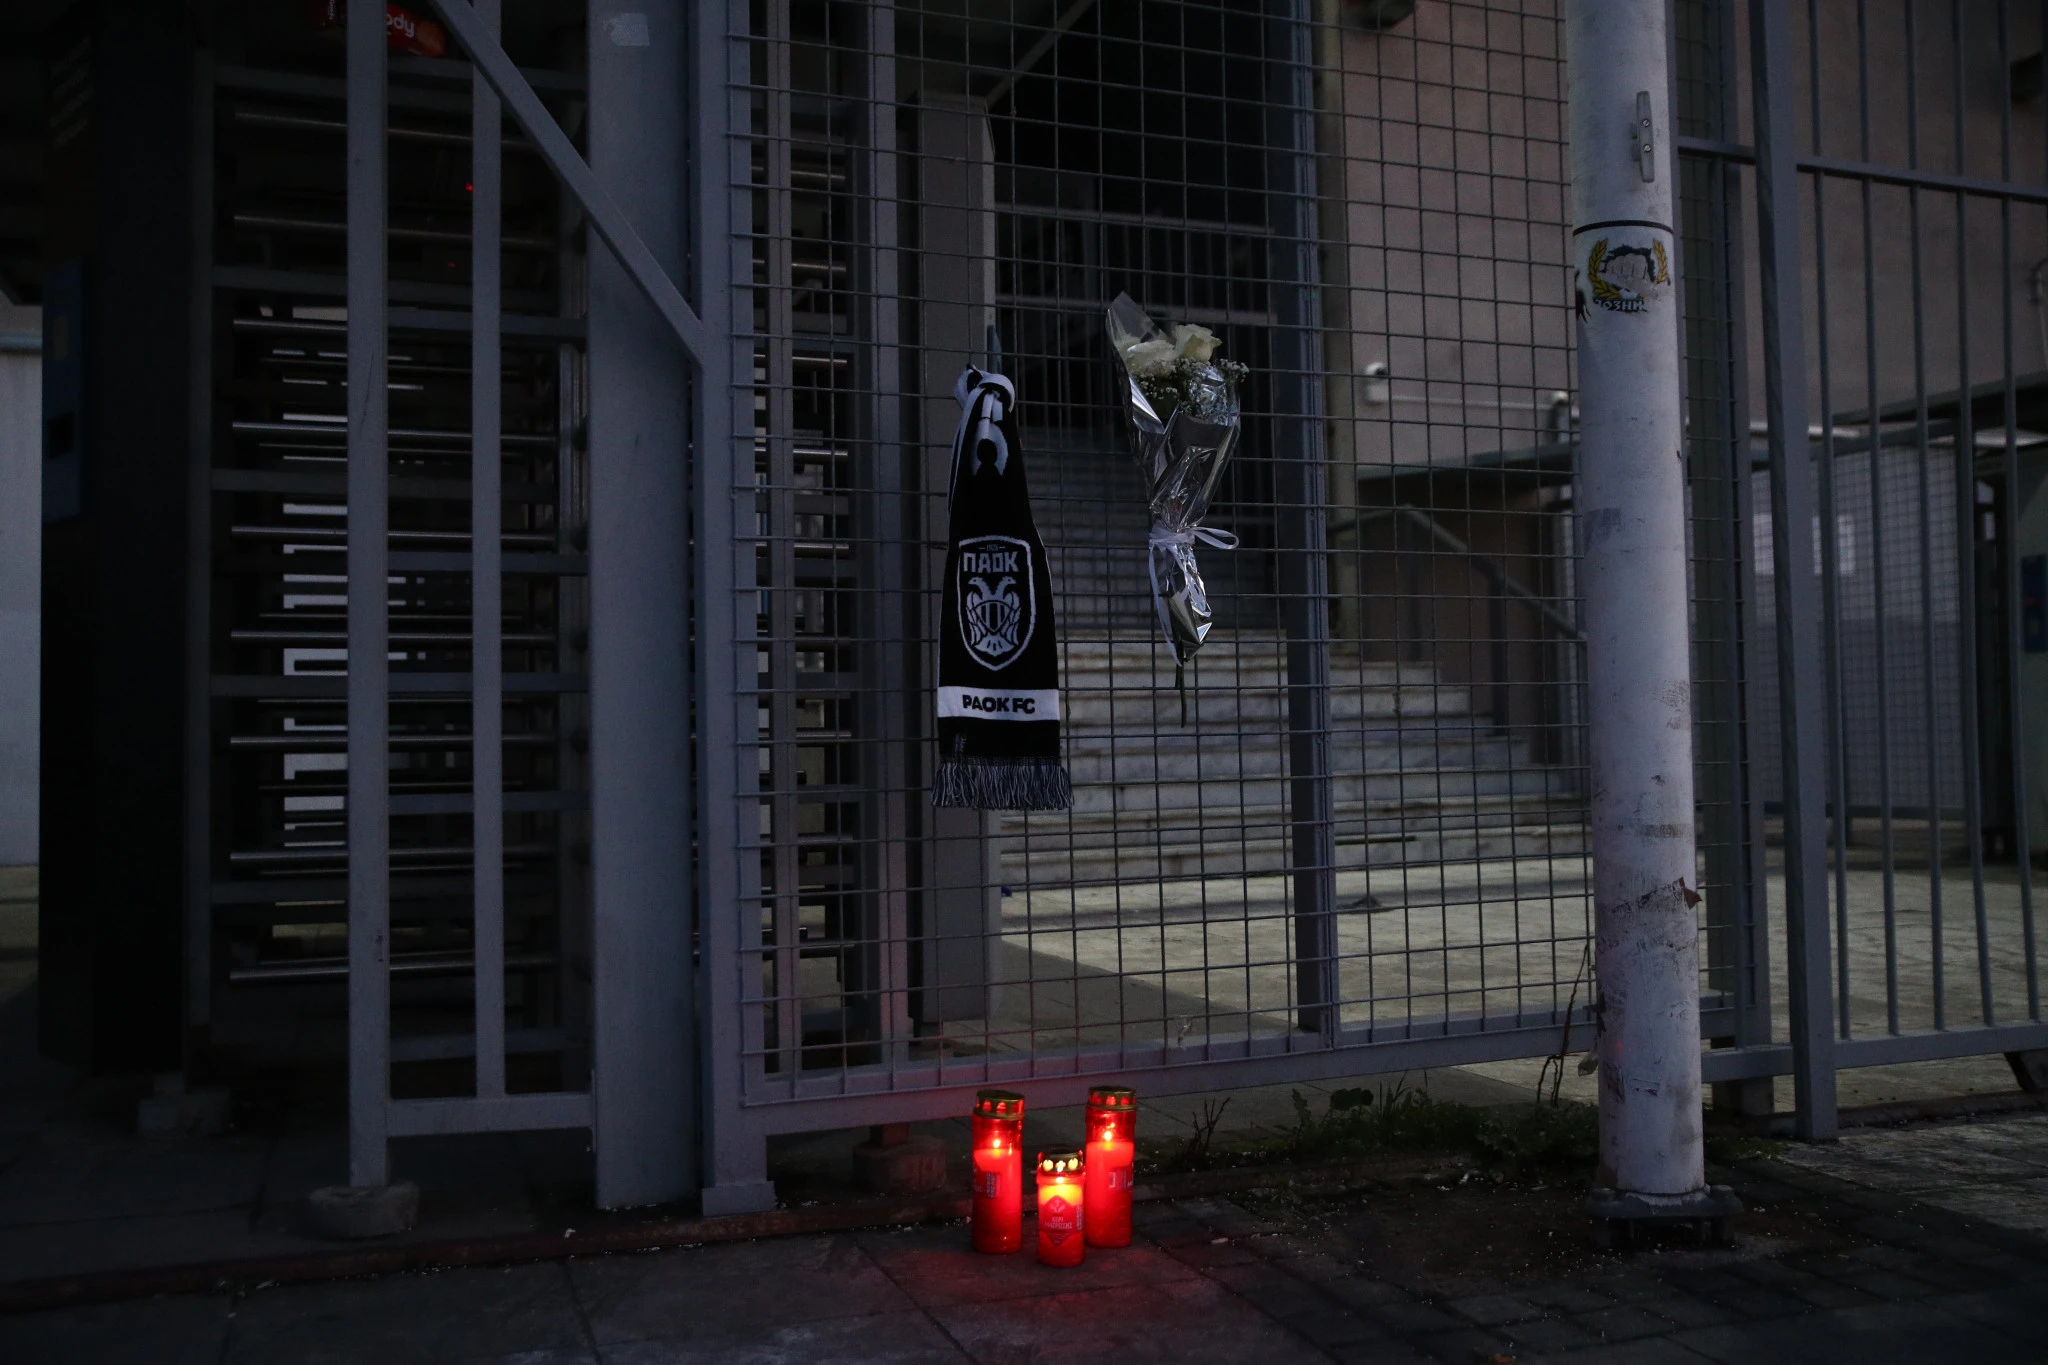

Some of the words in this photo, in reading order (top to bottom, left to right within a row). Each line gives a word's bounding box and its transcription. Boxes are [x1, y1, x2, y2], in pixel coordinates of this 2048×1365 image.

[963, 551, 1020, 573] ΠΑΟΚ
[962, 694, 1009, 713] PAOK
[1012, 698, 1035, 714] FC
